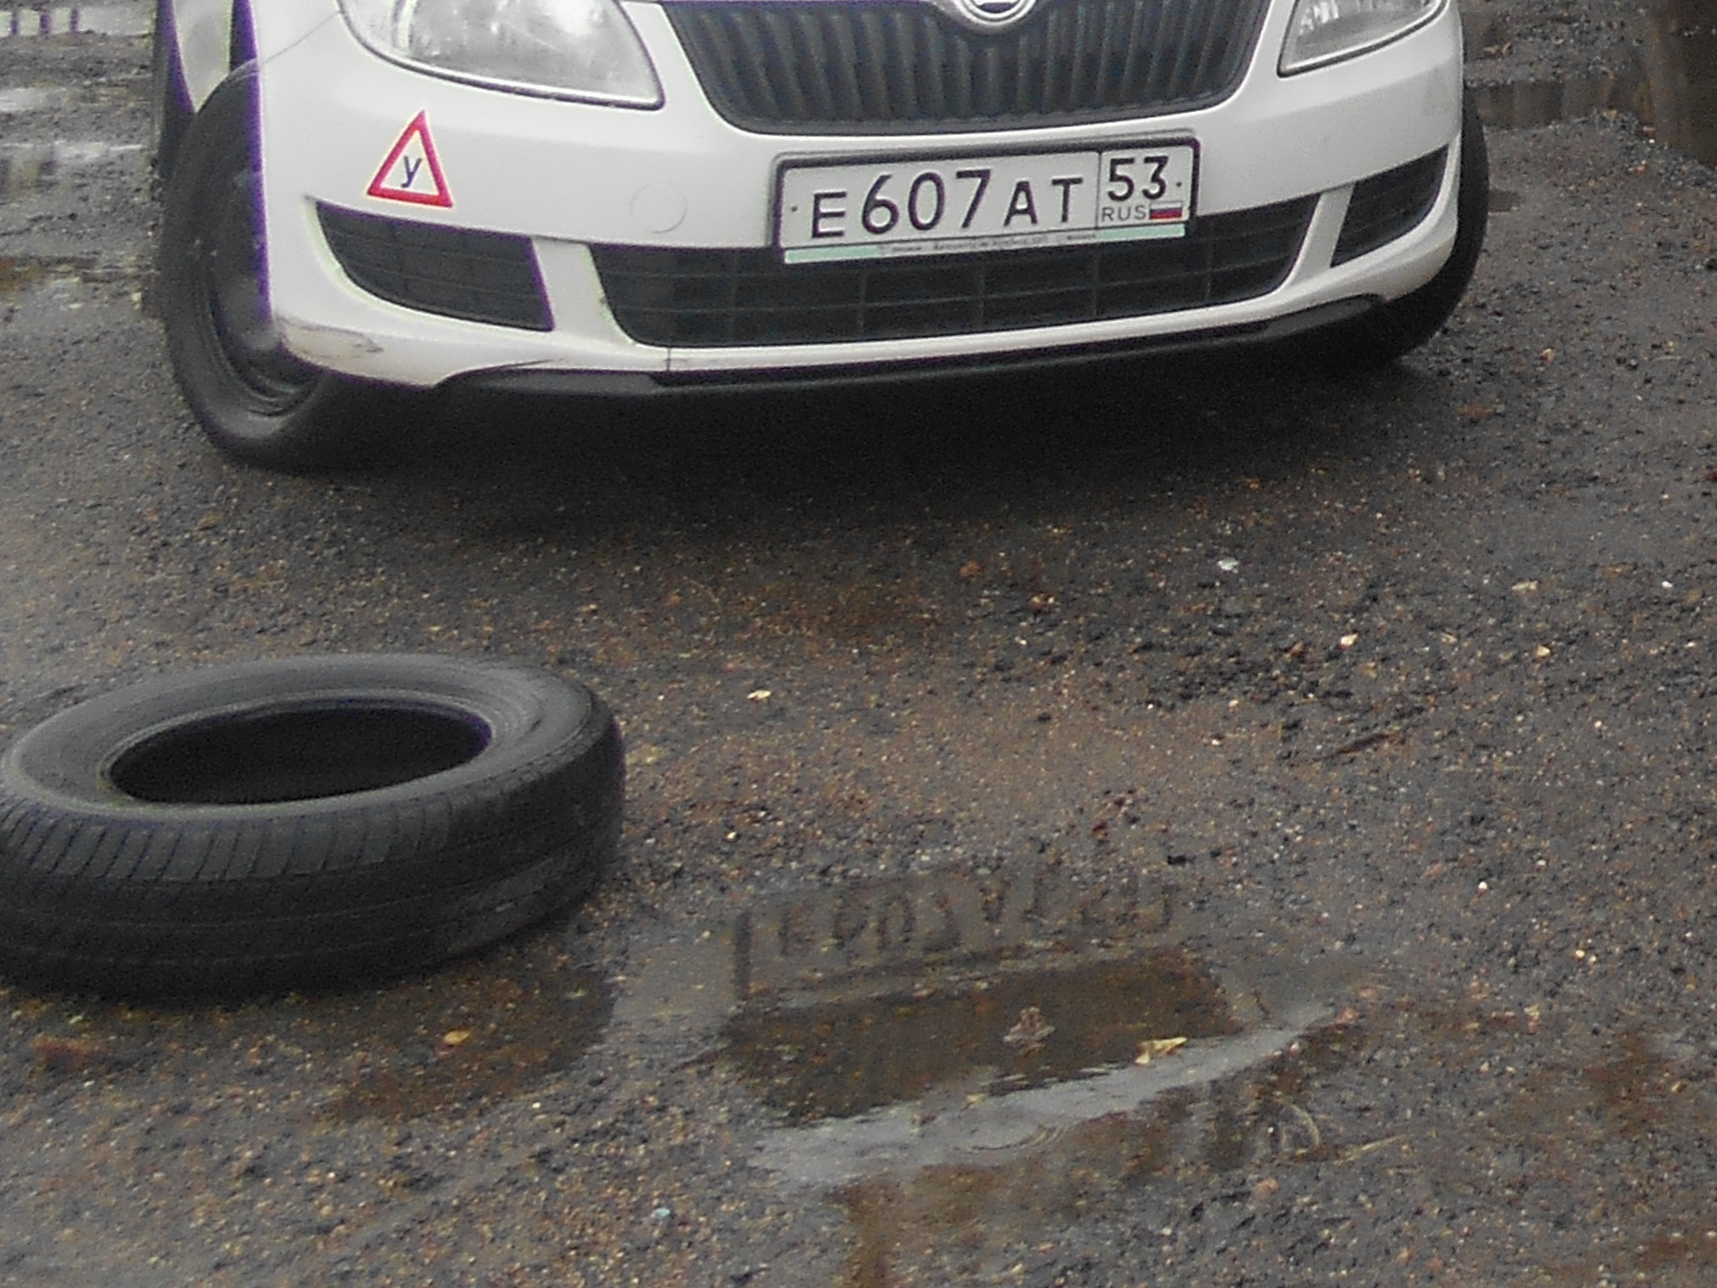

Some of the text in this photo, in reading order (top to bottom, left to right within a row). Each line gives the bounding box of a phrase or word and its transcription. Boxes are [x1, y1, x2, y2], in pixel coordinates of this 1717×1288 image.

[811, 155, 1168, 239] Е607АТ 53
[1101, 204, 1146, 223] RUS
